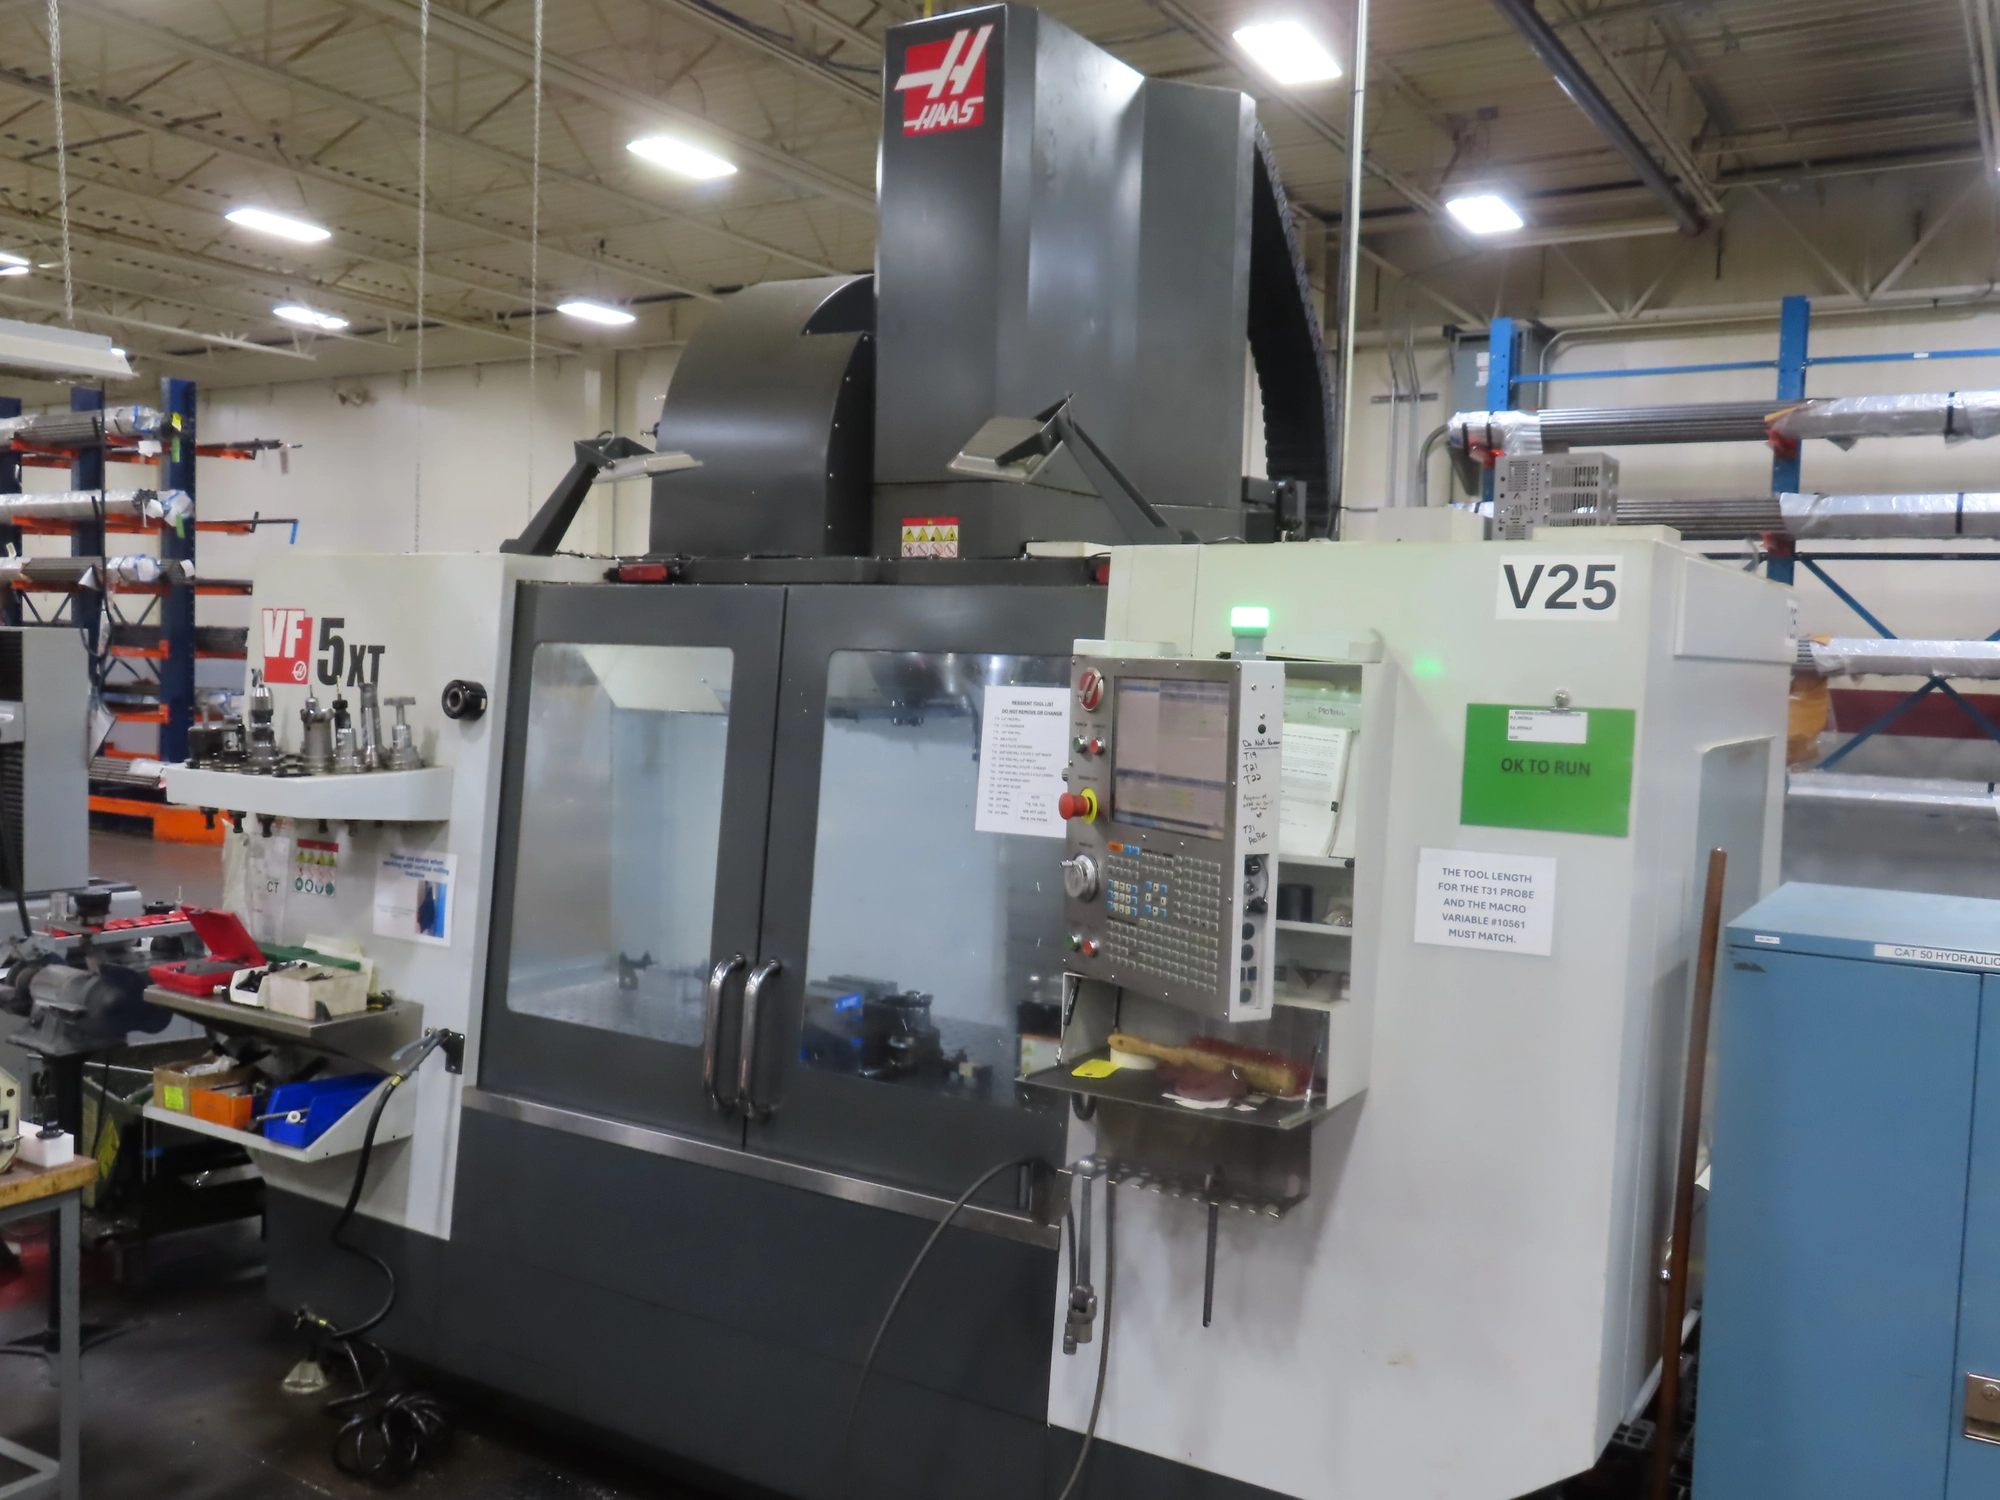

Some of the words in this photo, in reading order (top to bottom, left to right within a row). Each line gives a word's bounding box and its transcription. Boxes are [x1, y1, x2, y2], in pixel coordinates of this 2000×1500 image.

[903, 96, 984, 131] HAAS
[1503, 563, 1617, 611] V25
[262, 608, 306, 658] VF
[1242, 739, 1252, 747] Do
[1255, 738, 1265, 746] Not
[1243, 751, 1257, 760] T19
[1243, 763, 1258, 773] T21
[1501, 758, 1524, 773] OK
[1529, 759, 1550, 774] TO
[1555, 760, 1591, 776] RUN
[1243, 774, 1261, 784] T22
[1243, 824, 1255, 834] T31
[1442, 868, 1461, 877] THE
[1464, 869, 1489, 880] TOOL
[1492, 872, 1532, 883] LENGTH
[266, 881, 279, 893] CT
[1438, 882, 1458, 892] FOR
[1460, 884, 1479, 894] THE
[1482, 886, 1497, 895] T31
[1500, 888, 1534, 899] PROBE
[1443, 898, 1465, 908] AND
[1468, 900, 1487, 910] THE
[1489, 902, 1526, 914] MACRO
[1442, 912, 1489, 925] VARIABLE
[1491, 918, 1525, 929] #10561
[1448, 928, 1476, 939] MUST
[1478, 931, 1516, 943] MATCH.
[1894, 947, 1917, 957] CAT
[1920, 950, 1933, 959] 50
[1936, 952, 2000, 967] HYDRAULIC
